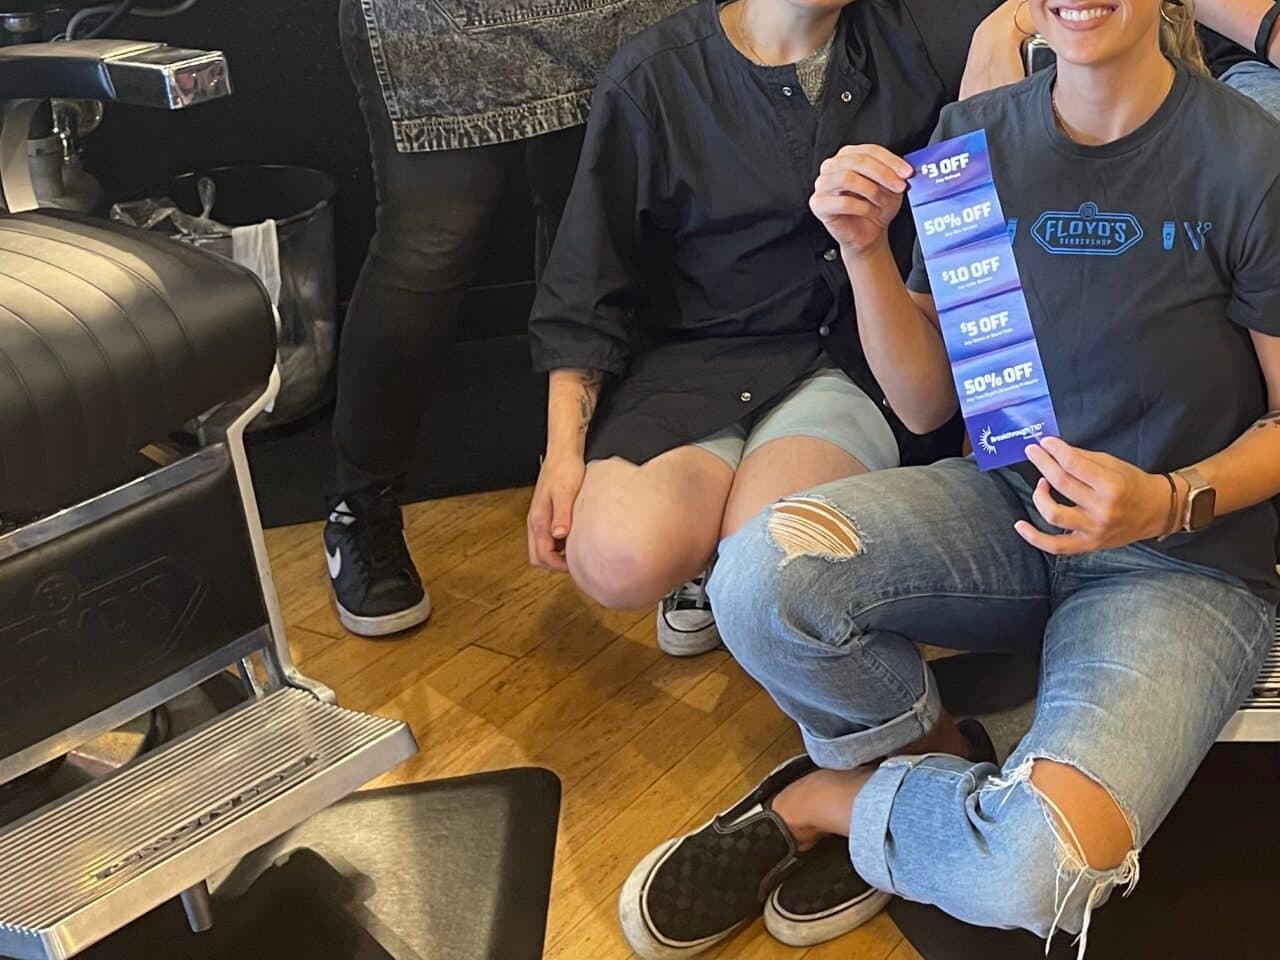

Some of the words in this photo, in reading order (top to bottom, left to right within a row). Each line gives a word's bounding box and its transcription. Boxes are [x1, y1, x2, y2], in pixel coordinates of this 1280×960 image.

[921, 163, 938, 178] $3
[939, 152, 970, 174] OFF
[924, 212, 961, 236] 50%
[962, 201, 992, 223] OFF
[1044, 219, 1128, 244] FLOYD'S
[1059, 237, 1112, 247] BARBERSHOP
[942, 265, 970, 286] $10
[970, 256, 1000, 278] OFF
[960, 320, 978, 337] $5
[979, 310, 1009, 333] OFF
[964, 371, 1003, 395] 50%
[1003, 361, 1033, 383] OFF
